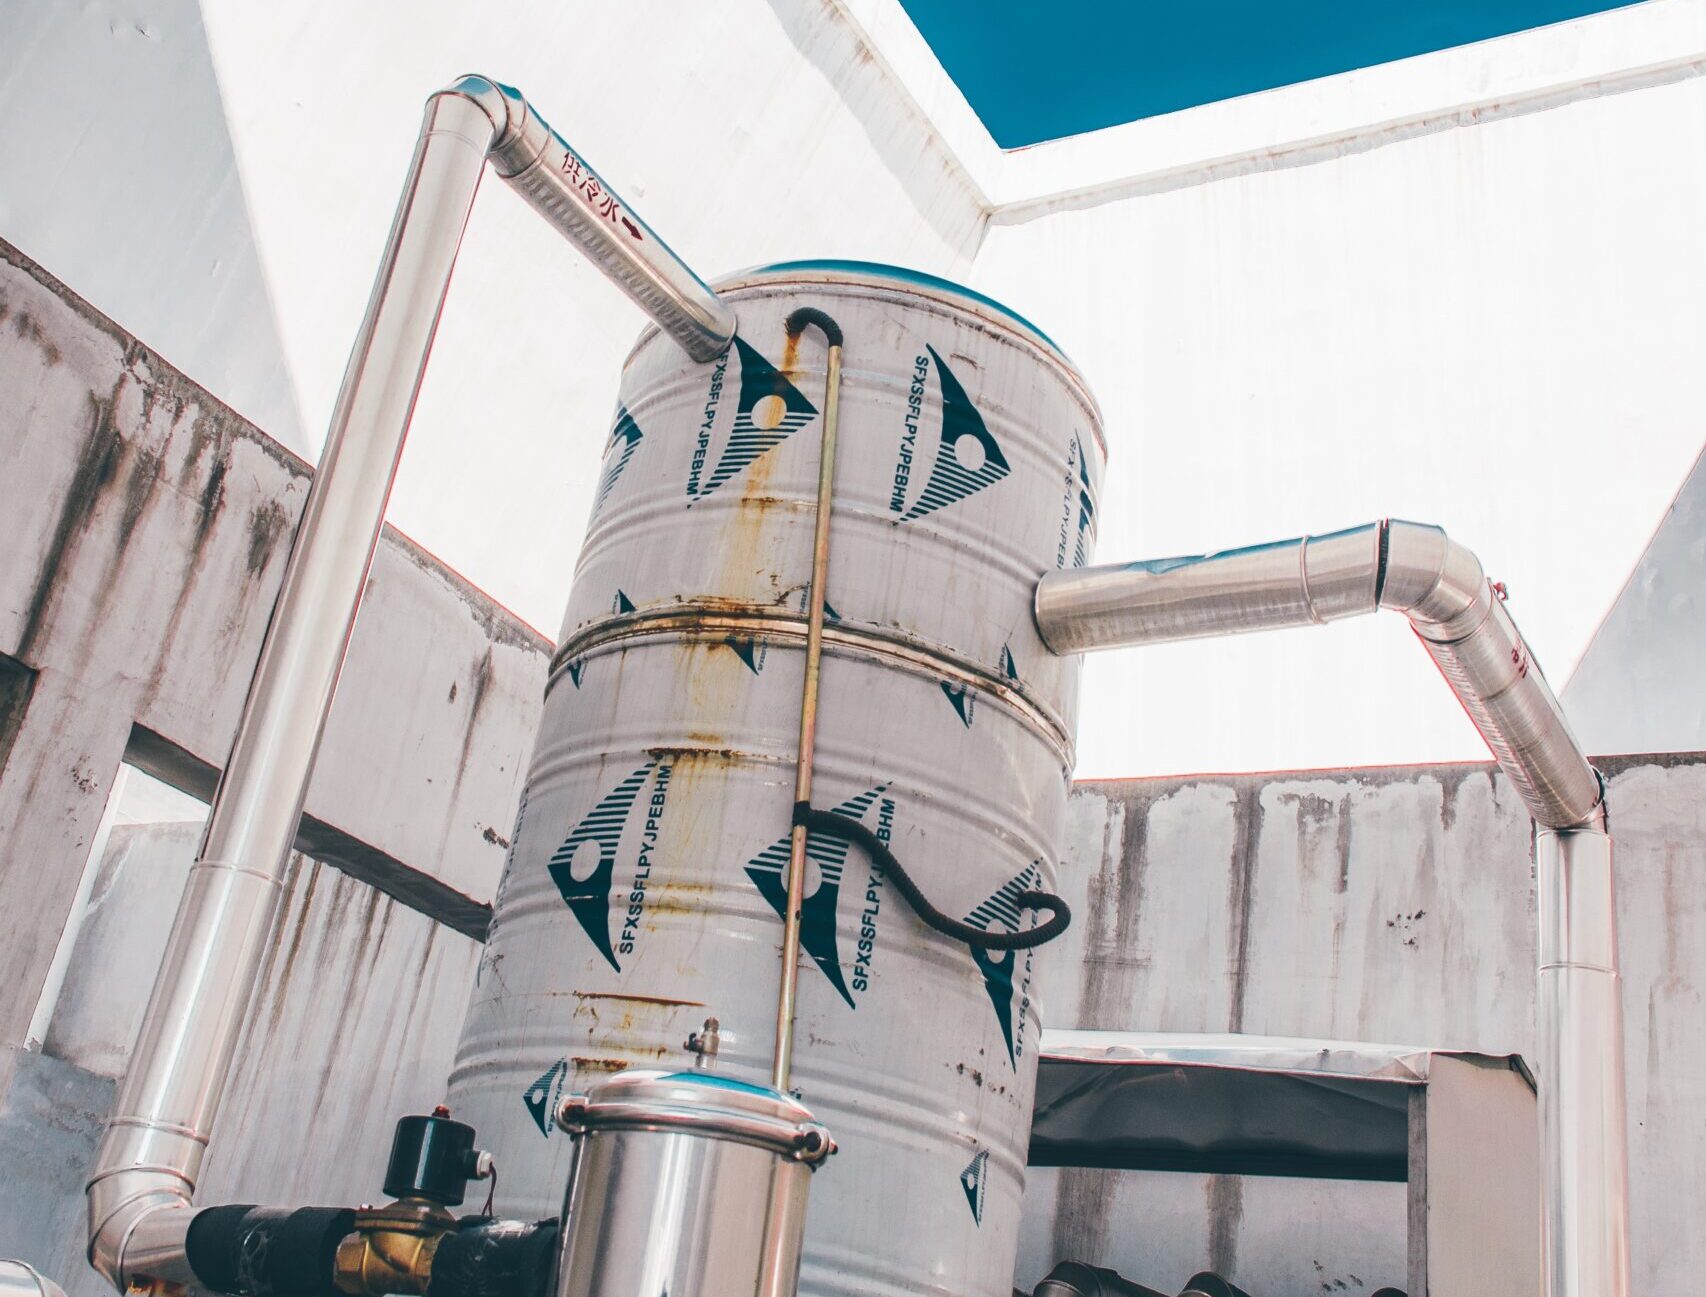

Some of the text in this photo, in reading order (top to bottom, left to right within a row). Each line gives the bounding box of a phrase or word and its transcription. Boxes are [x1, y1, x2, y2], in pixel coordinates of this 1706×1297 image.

[686, 352, 729, 495] FXSSFLPYJPEBHM
[889, 355, 929, 513] SFXSSFLPYJPEBHM
[620, 764, 673, 954] SFXSSFLPYJPEBHM
